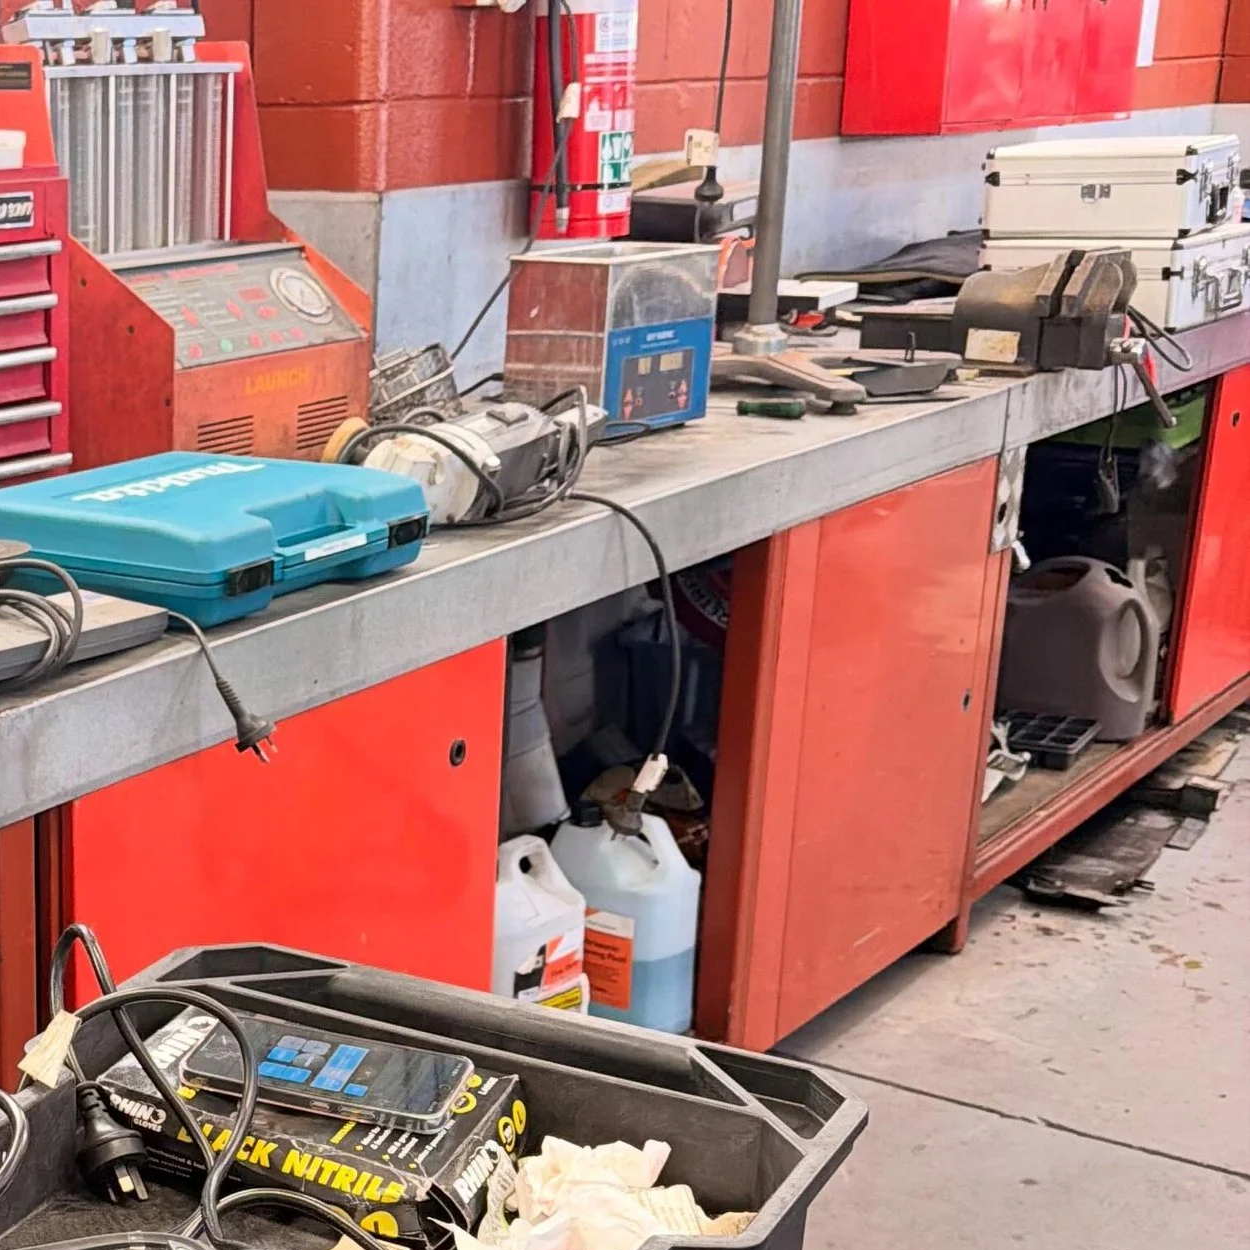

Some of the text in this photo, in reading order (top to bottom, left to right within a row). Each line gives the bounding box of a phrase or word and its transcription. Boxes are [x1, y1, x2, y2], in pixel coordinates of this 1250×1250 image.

[244, 364, 308, 395] LAUNCH
[133, 1117, 163, 1133] GLOVES
[283, 1148, 407, 1204] NITRILE
